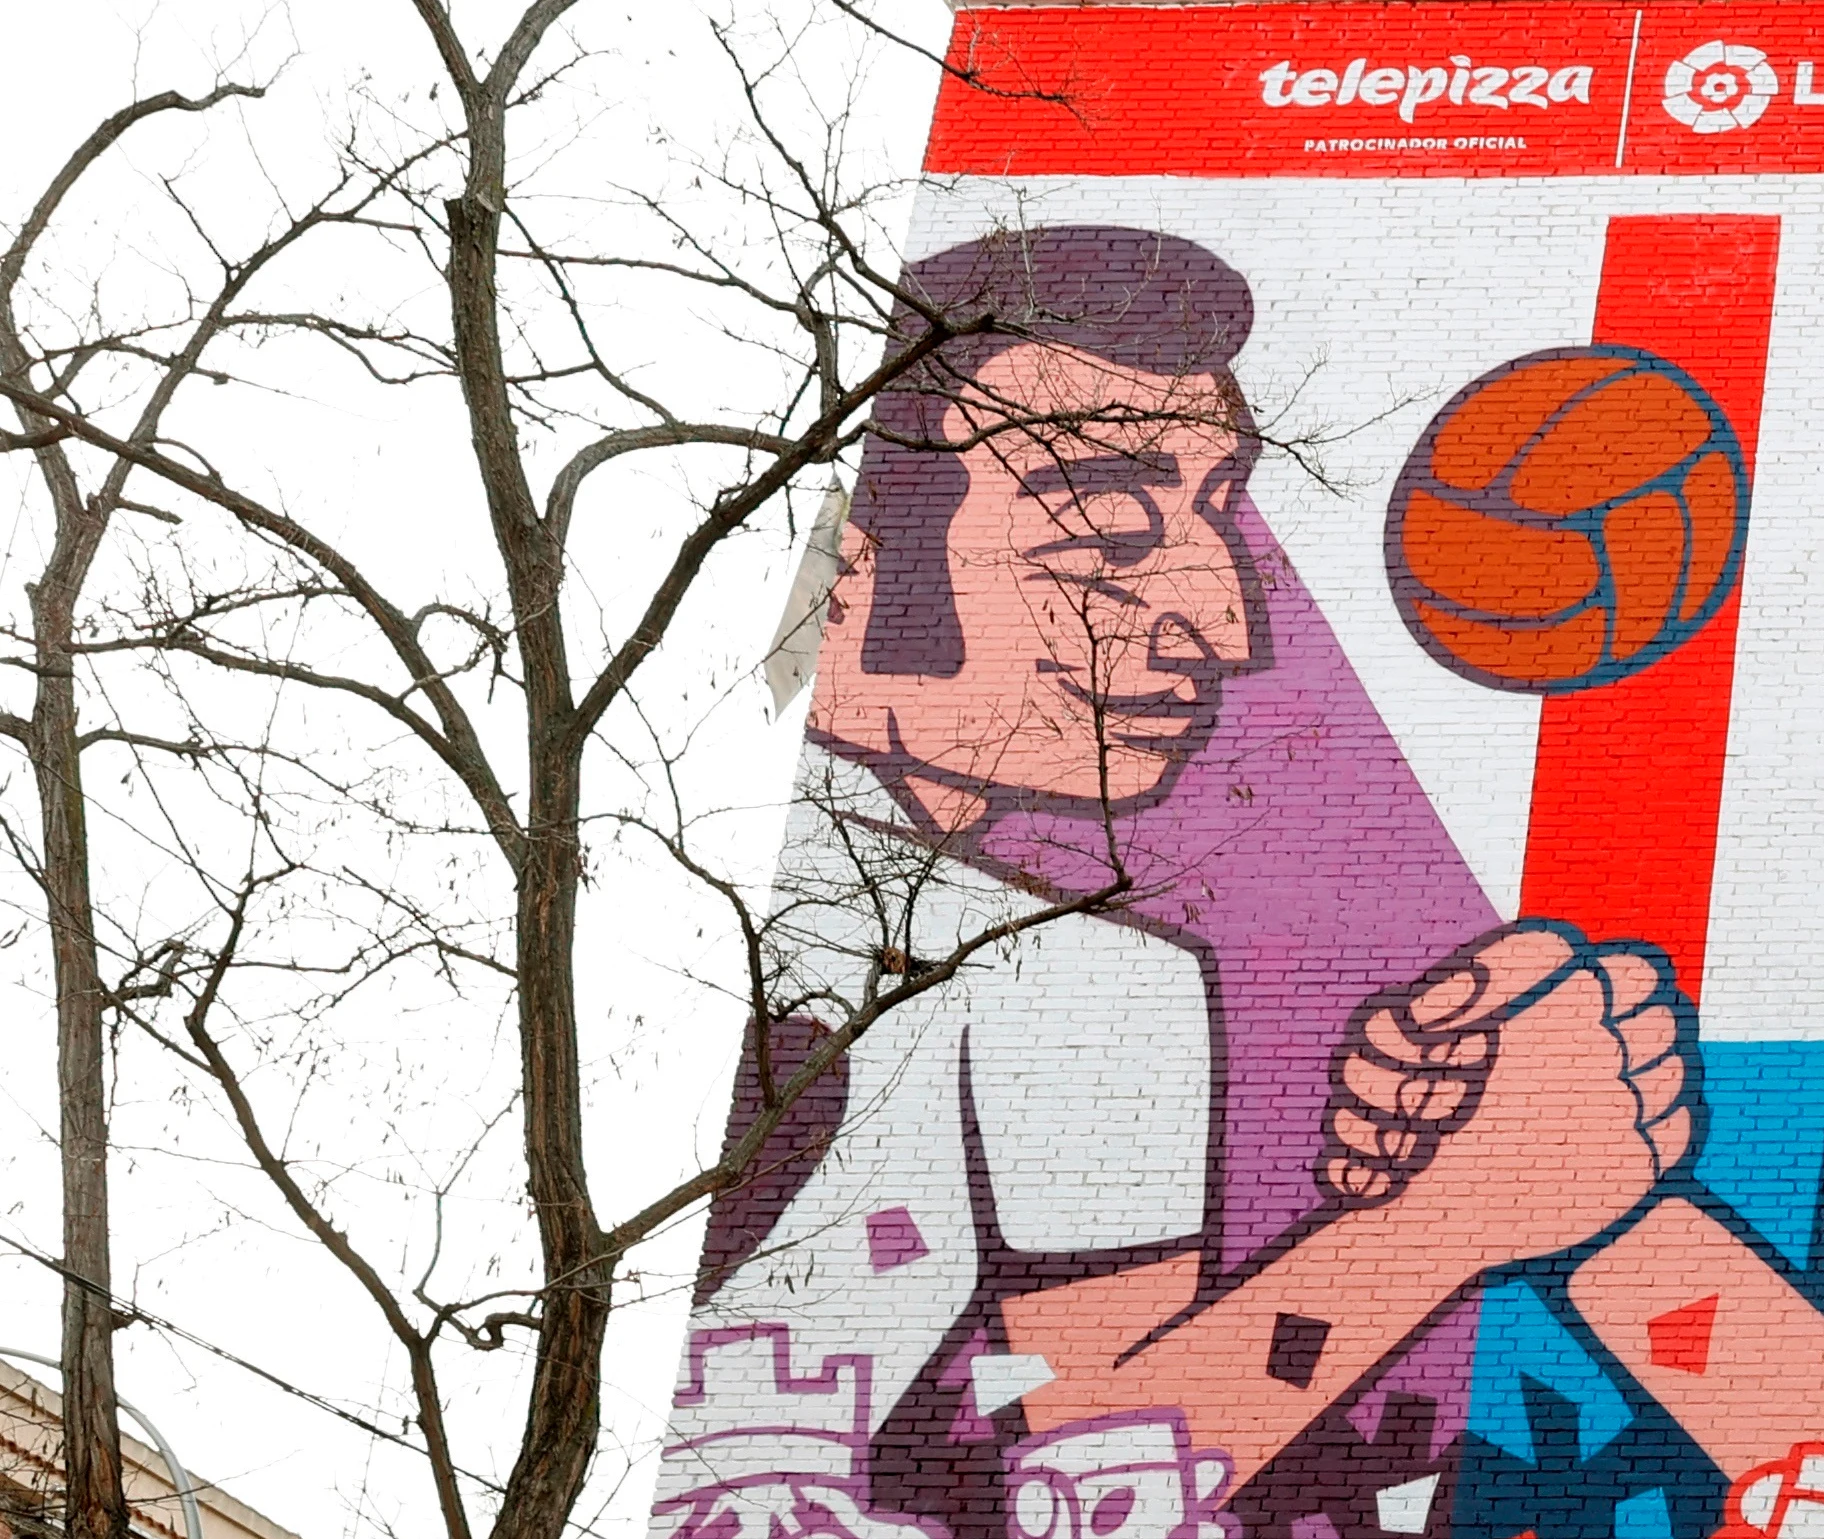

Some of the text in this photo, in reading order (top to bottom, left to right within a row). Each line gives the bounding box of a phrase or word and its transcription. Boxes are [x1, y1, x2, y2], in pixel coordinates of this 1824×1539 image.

[1258, 55, 1594, 124] telepizza
[1303, 136, 1528, 152] PATROCINADOR OFICIAL
